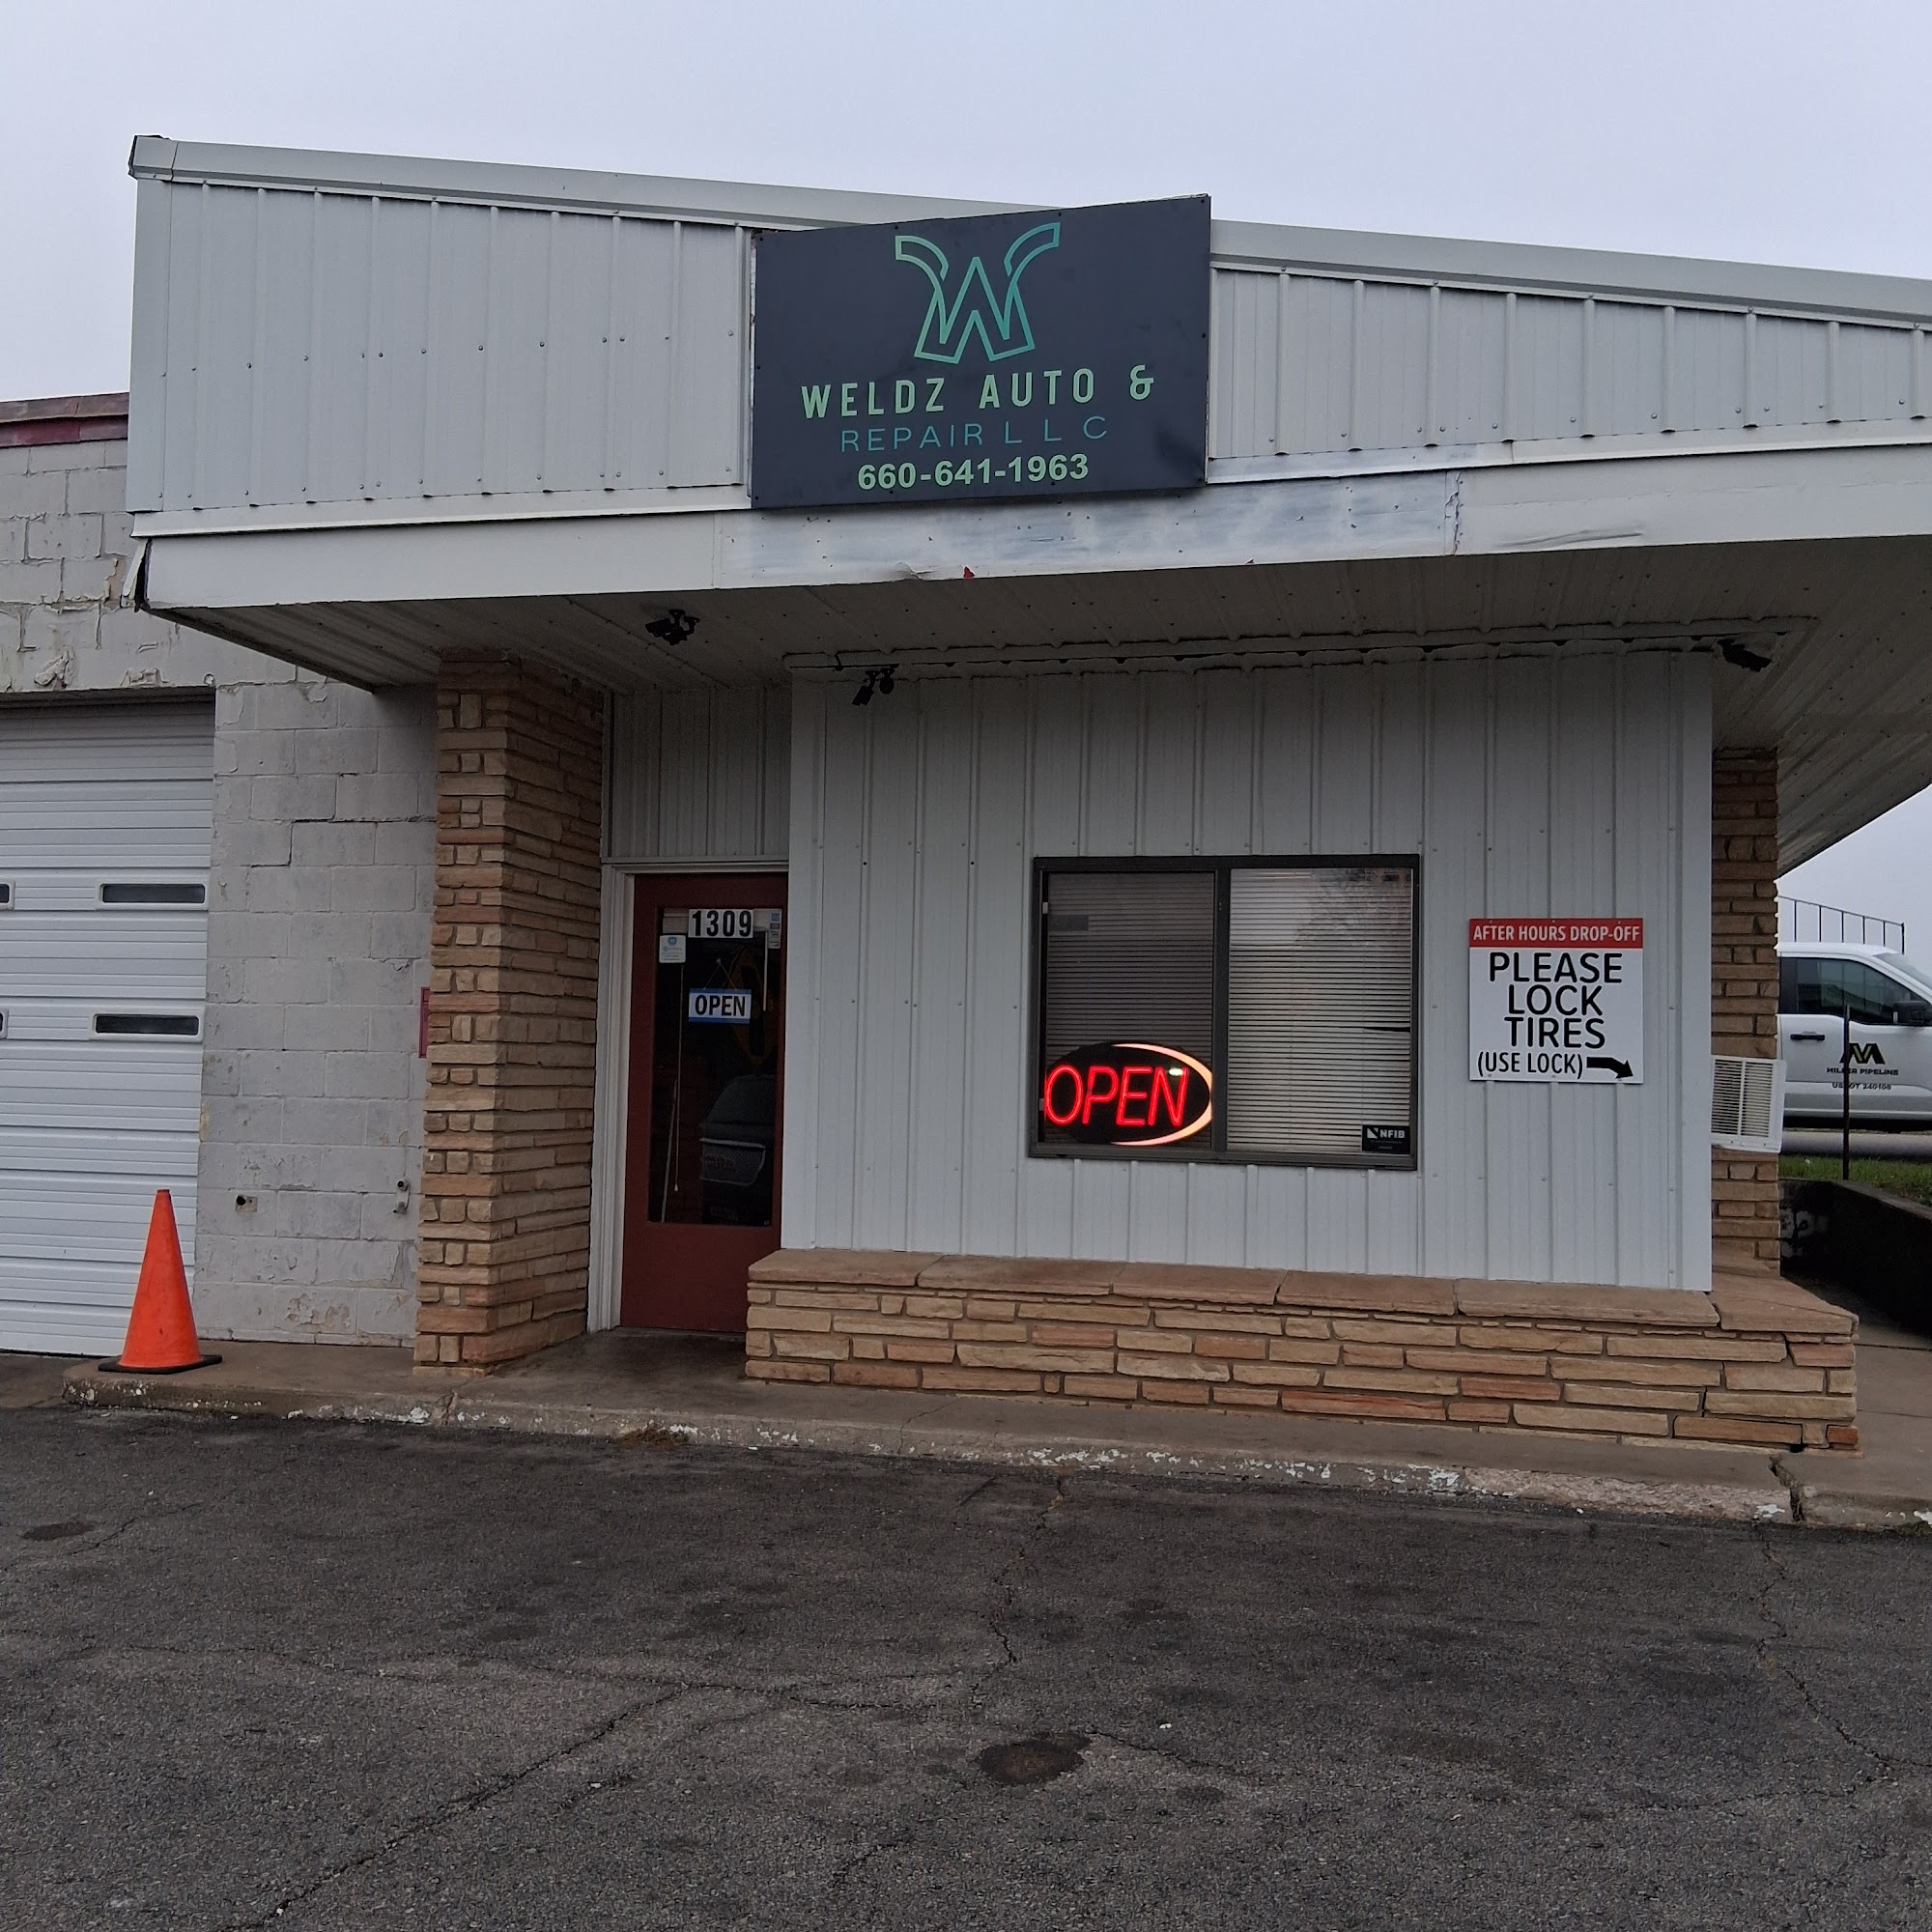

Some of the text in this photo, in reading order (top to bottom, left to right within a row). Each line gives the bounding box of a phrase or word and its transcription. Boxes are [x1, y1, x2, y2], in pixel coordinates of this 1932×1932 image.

[801, 364, 1154, 419] WELDZ AUTO &
[841, 423, 983, 453] REPAIR
[857, 453, 1090, 490] 660-641-1963
[692, 910, 752, 937] 1309
[1473, 925, 1640, 942] AFTER HOURS DROP-OFF
[1489, 952, 1623, 983] PLEASE
[695, 994, 746, 1017] OPEN
[1508, 984, 1604, 1016] LOCK
[1503, 1016, 1605, 1049] TIRES
[1478, 1051, 1583, 1080] (USE LOCK)
[1043, 1065, 1189, 1126] OPEN
[1379, 1129, 1406, 1139] NFIB
